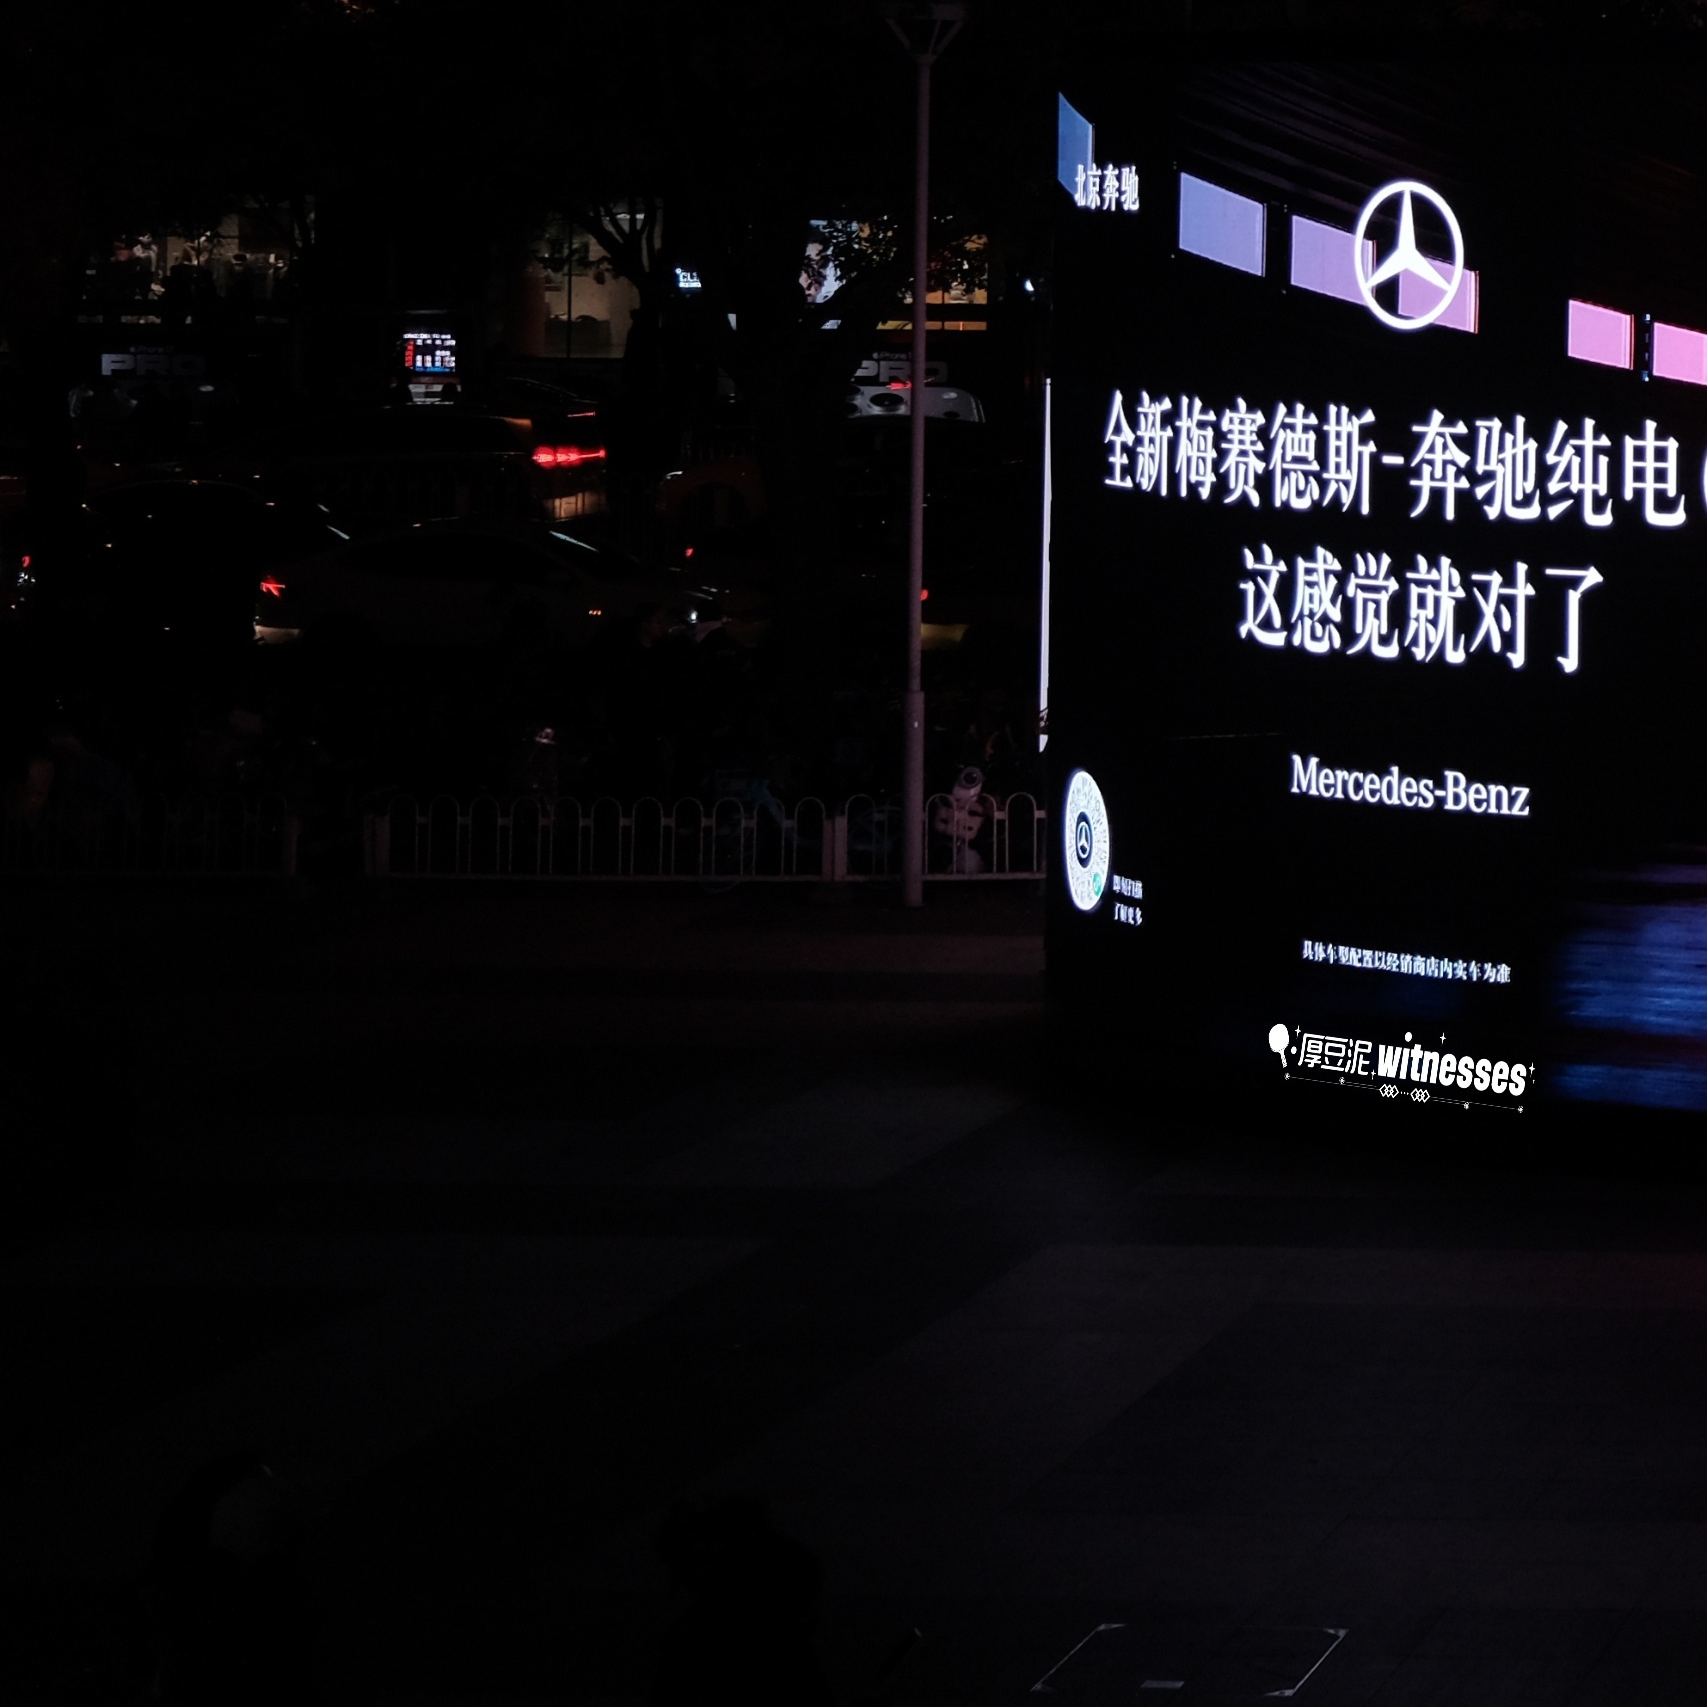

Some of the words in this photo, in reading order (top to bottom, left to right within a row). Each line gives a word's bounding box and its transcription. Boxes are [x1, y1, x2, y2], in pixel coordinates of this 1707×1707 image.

[1074, 162, 1140, 212] 北京奔驰
[1104, 389, 1687, 527] 全新梅赛德斯-奔驰纯电
[1239, 543, 1604, 674] 这感觉就对了
[1290, 754, 1530, 816] Mercedes-Benz
[1377, 1043, 1527, 1096] witnesses
